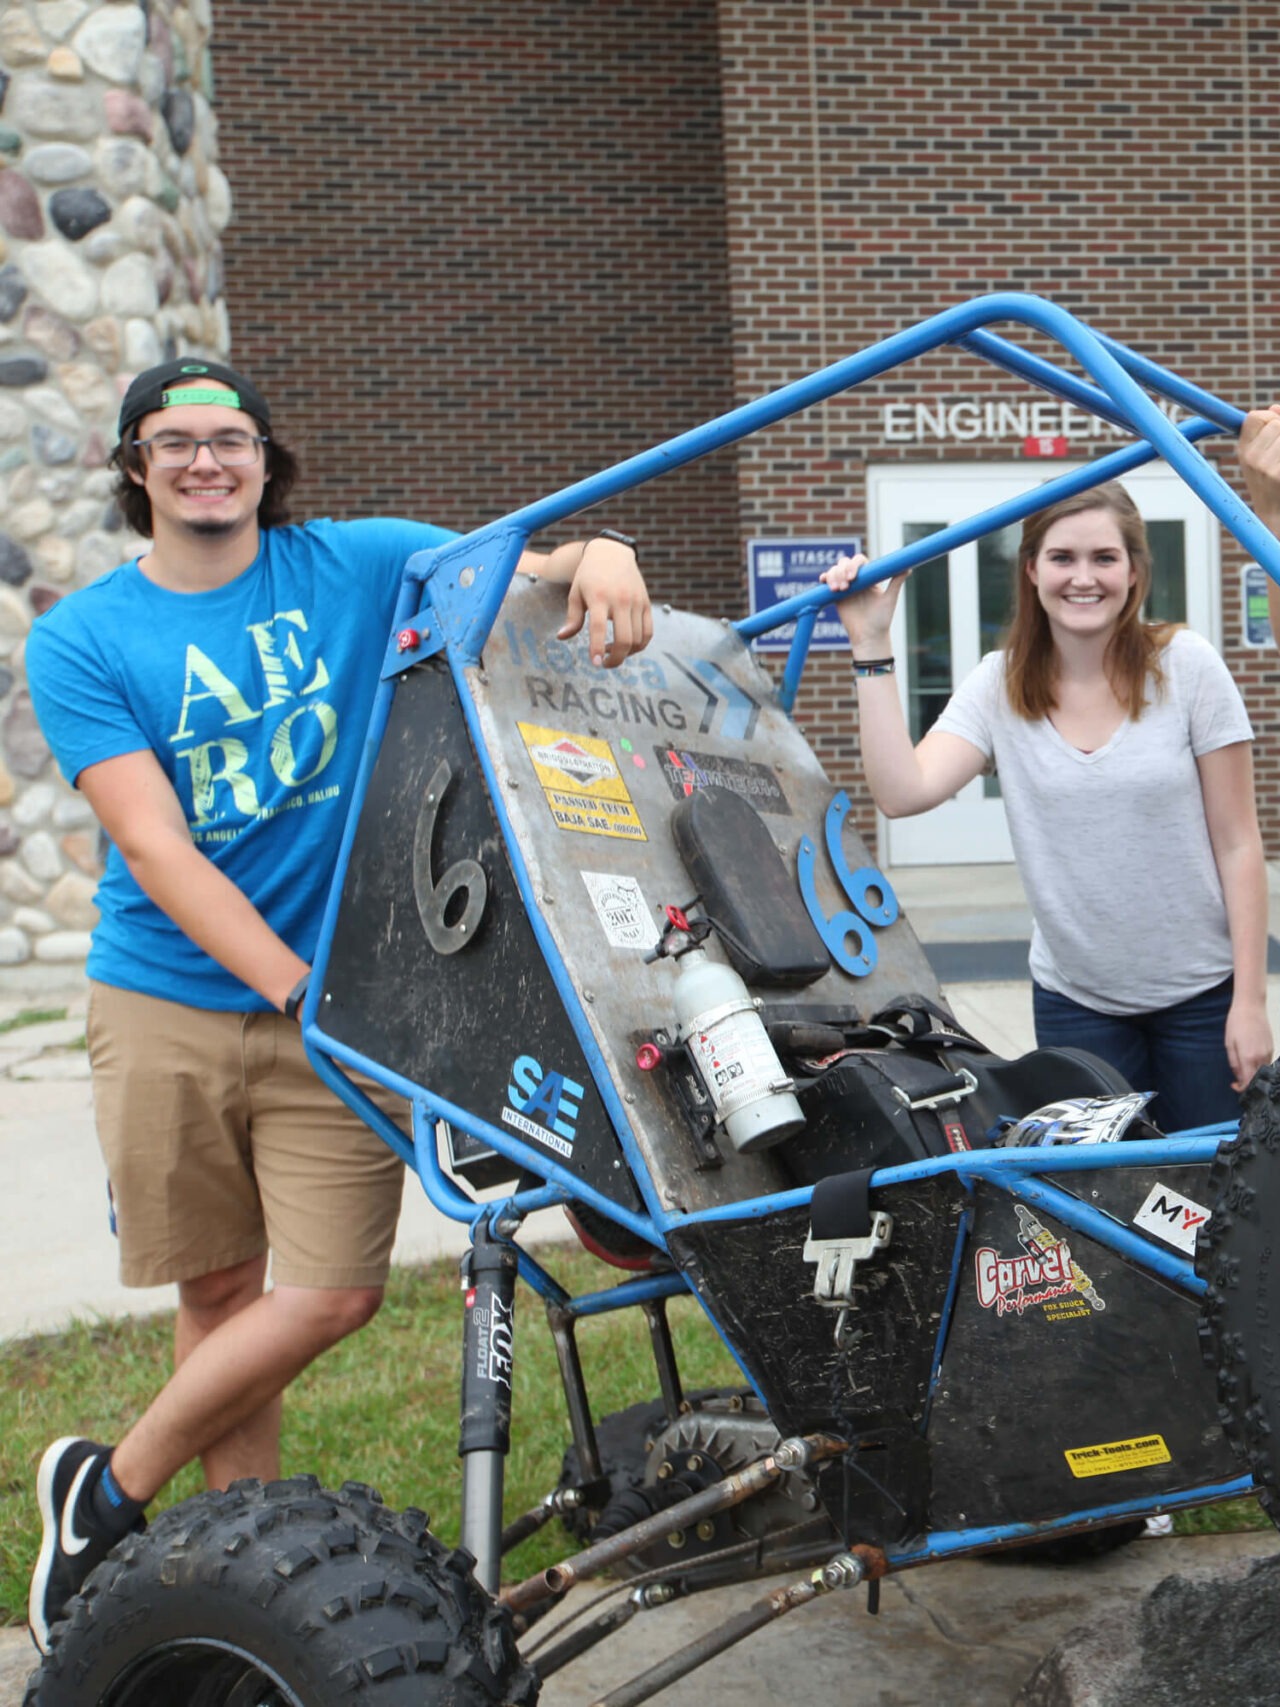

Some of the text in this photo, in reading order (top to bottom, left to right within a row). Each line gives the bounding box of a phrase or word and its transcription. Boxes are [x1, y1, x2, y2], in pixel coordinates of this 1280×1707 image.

[884, 402, 1186, 440] ENGINEE
[494, 619, 670, 691] Itasca
[525, 675, 687, 730] RACING
[554, 810, 586, 827] BAJA
[507, 1055, 585, 1142] SAE
[503, 1108, 571, 1157] INTERNATIONAL
[976, 1239, 1076, 1307] Carver
[997, 1282, 1075, 1316] Performance
[1045, 1309, 1092, 1322] SPECIALIST
[489, 1291, 514, 1391] FOX
[1071, 1438, 1160, 1461] Trick-Tools.com
